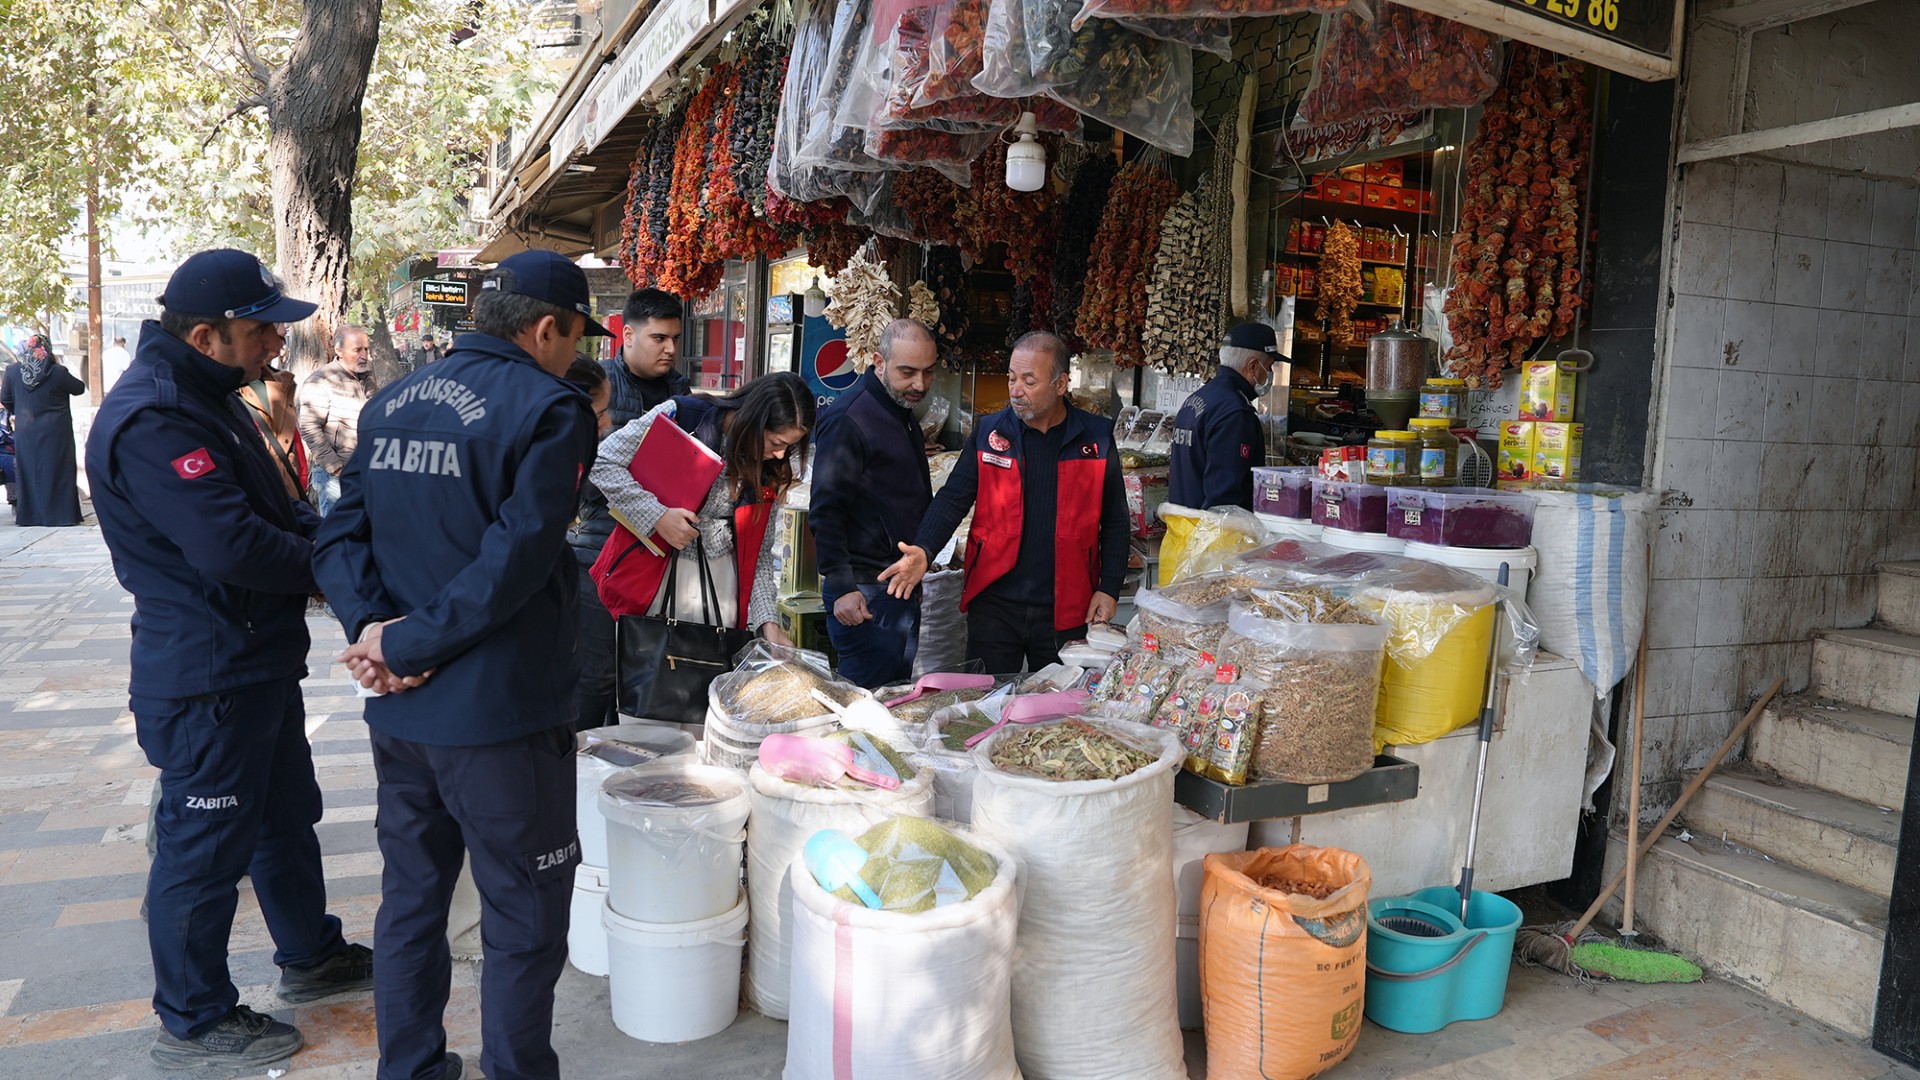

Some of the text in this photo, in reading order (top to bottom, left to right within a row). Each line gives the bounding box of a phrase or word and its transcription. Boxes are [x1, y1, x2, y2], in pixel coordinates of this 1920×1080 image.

[369, 438, 461, 477] ZABITA
[186, 795, 238, 810] ZABITA
[536, 841, 577, 870] ZABITA
